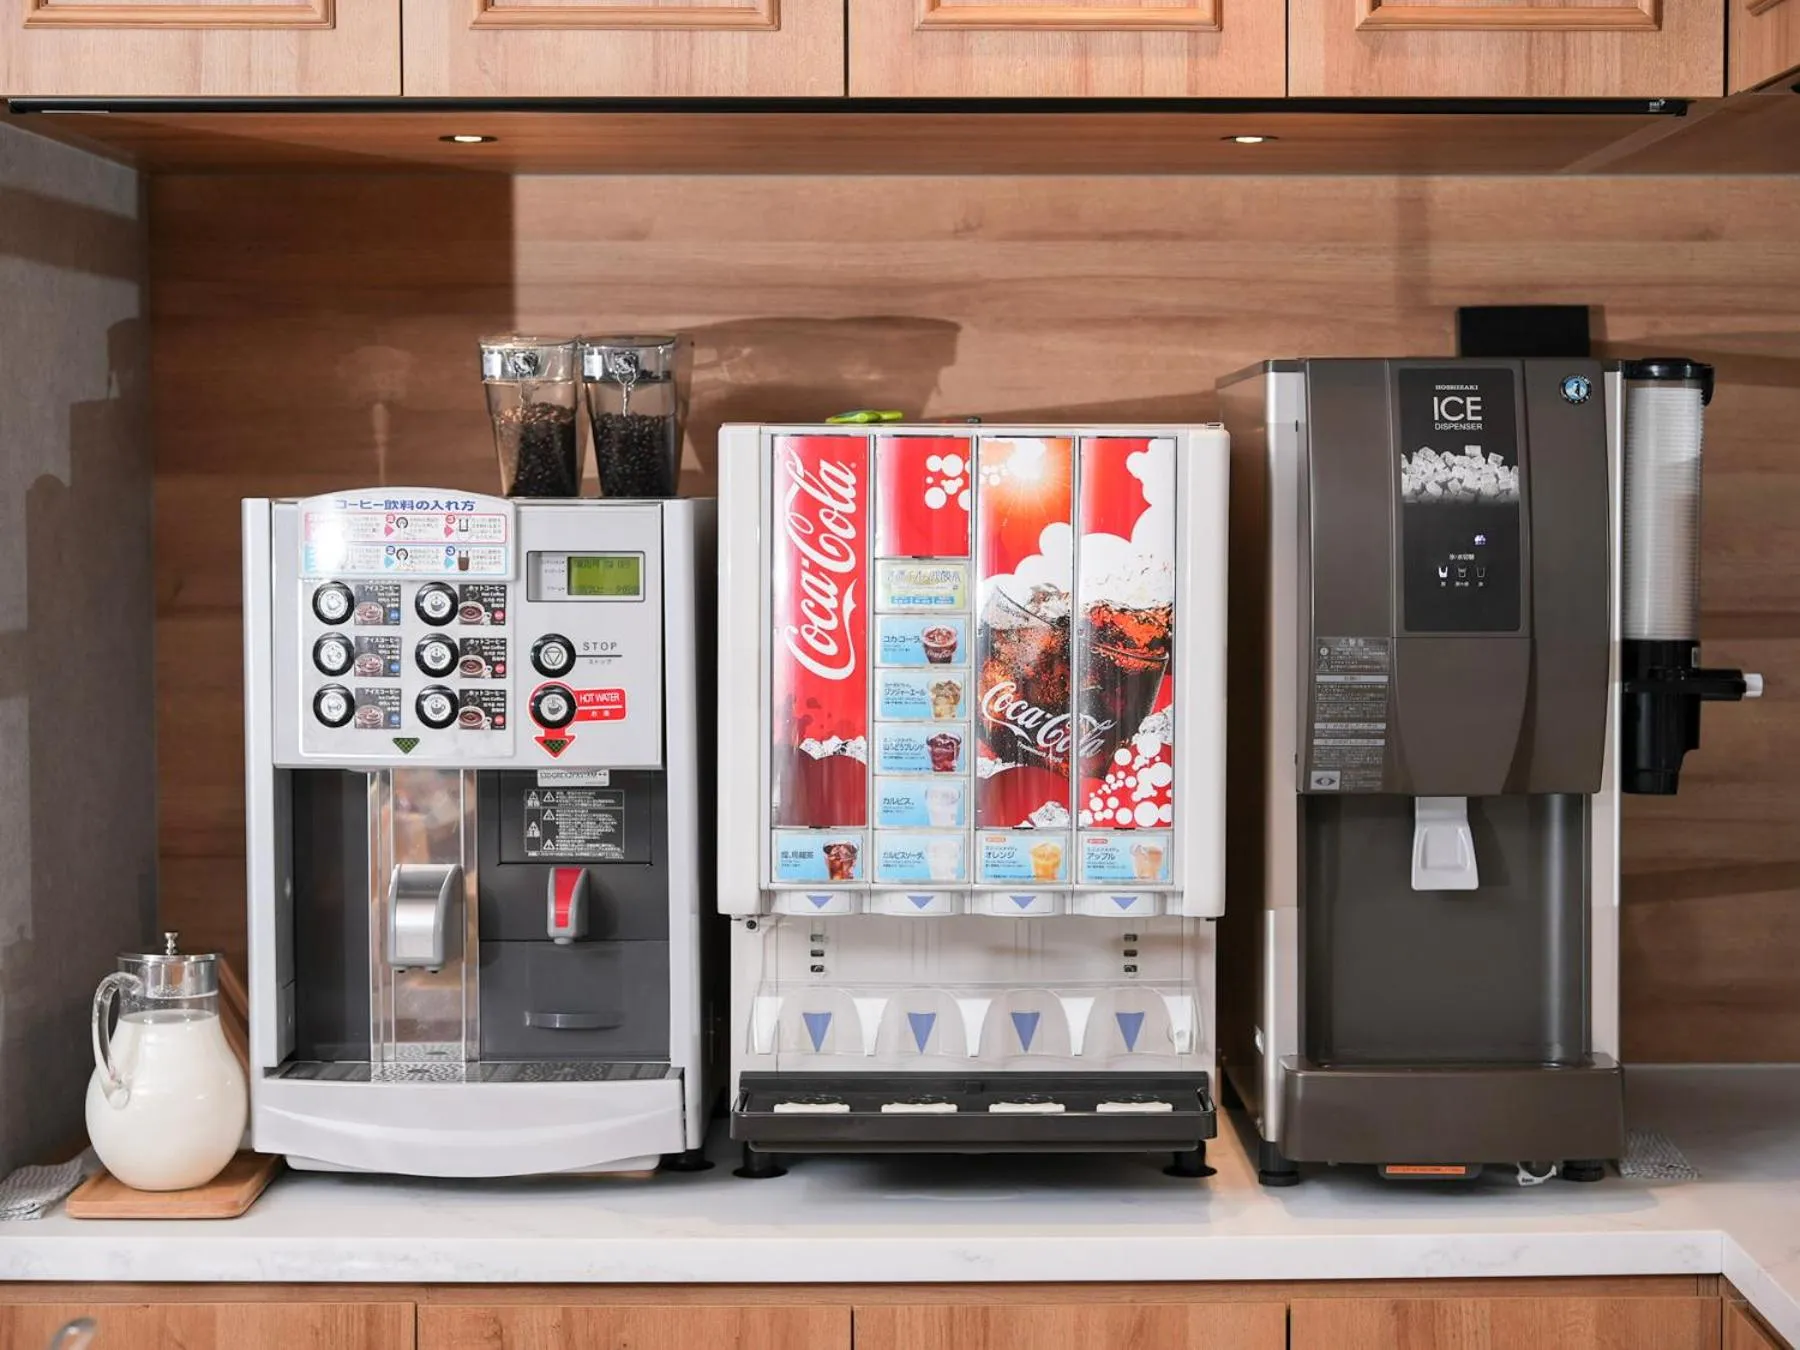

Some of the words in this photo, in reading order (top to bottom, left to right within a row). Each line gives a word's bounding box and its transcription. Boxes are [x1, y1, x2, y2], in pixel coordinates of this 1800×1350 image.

[1433, 396, 1482, 421] ICE
[336, 499, 476, 512] コーヒー飲料の入れ方
[785, 442, 857, 680] Coca-Cola
[583, 642, 617, 651] STOP
[580, 693, 595, 703] HOT
[596, 692, 620, 702] WATER
[986, 851, 1014, 859] オレンジ
[1087, 853, 1116, 861] アップル
